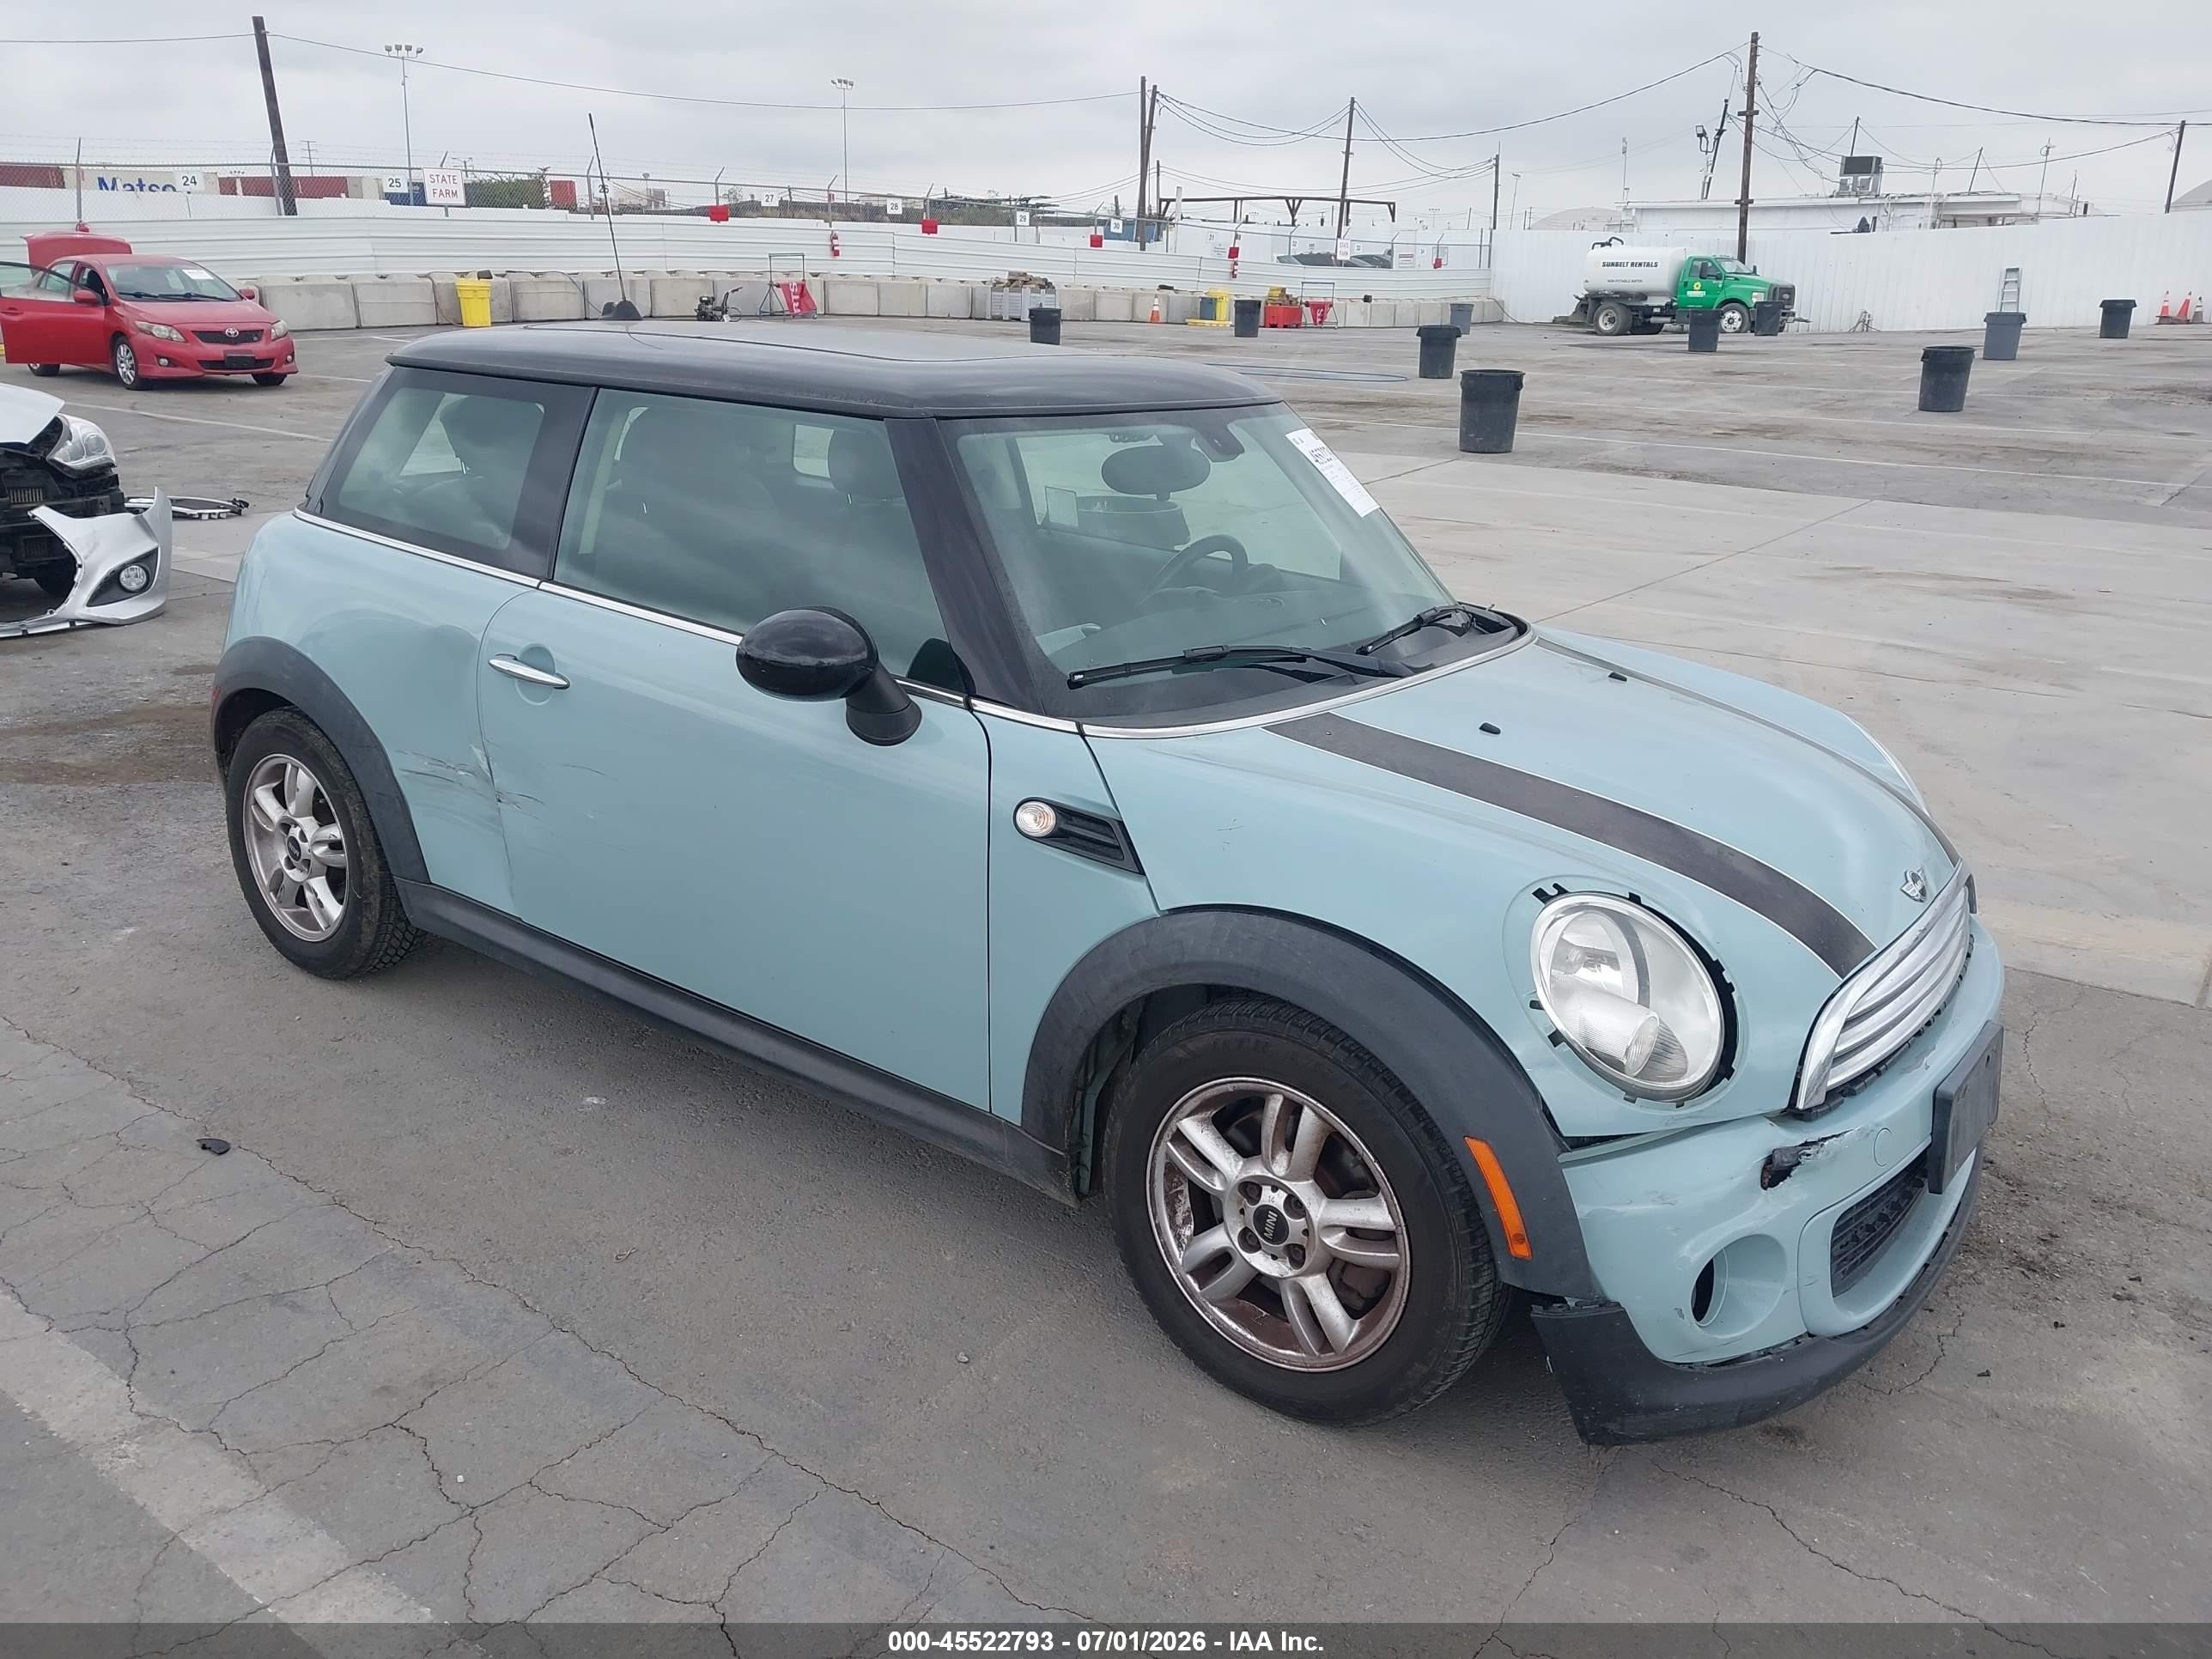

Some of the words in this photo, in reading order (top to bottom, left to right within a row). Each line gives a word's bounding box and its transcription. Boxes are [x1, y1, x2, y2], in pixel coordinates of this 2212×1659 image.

[181, 175, 198, 186] 24
[388, 178, 402, 188] 25
[428, 174, 458, 184] STATE
[432, 189, 459, 198] FARM
[765, 194, 774, 203] 27
[890, 202, 899, 210] 28
[1263, 1210, 1279, 1240] MINI
